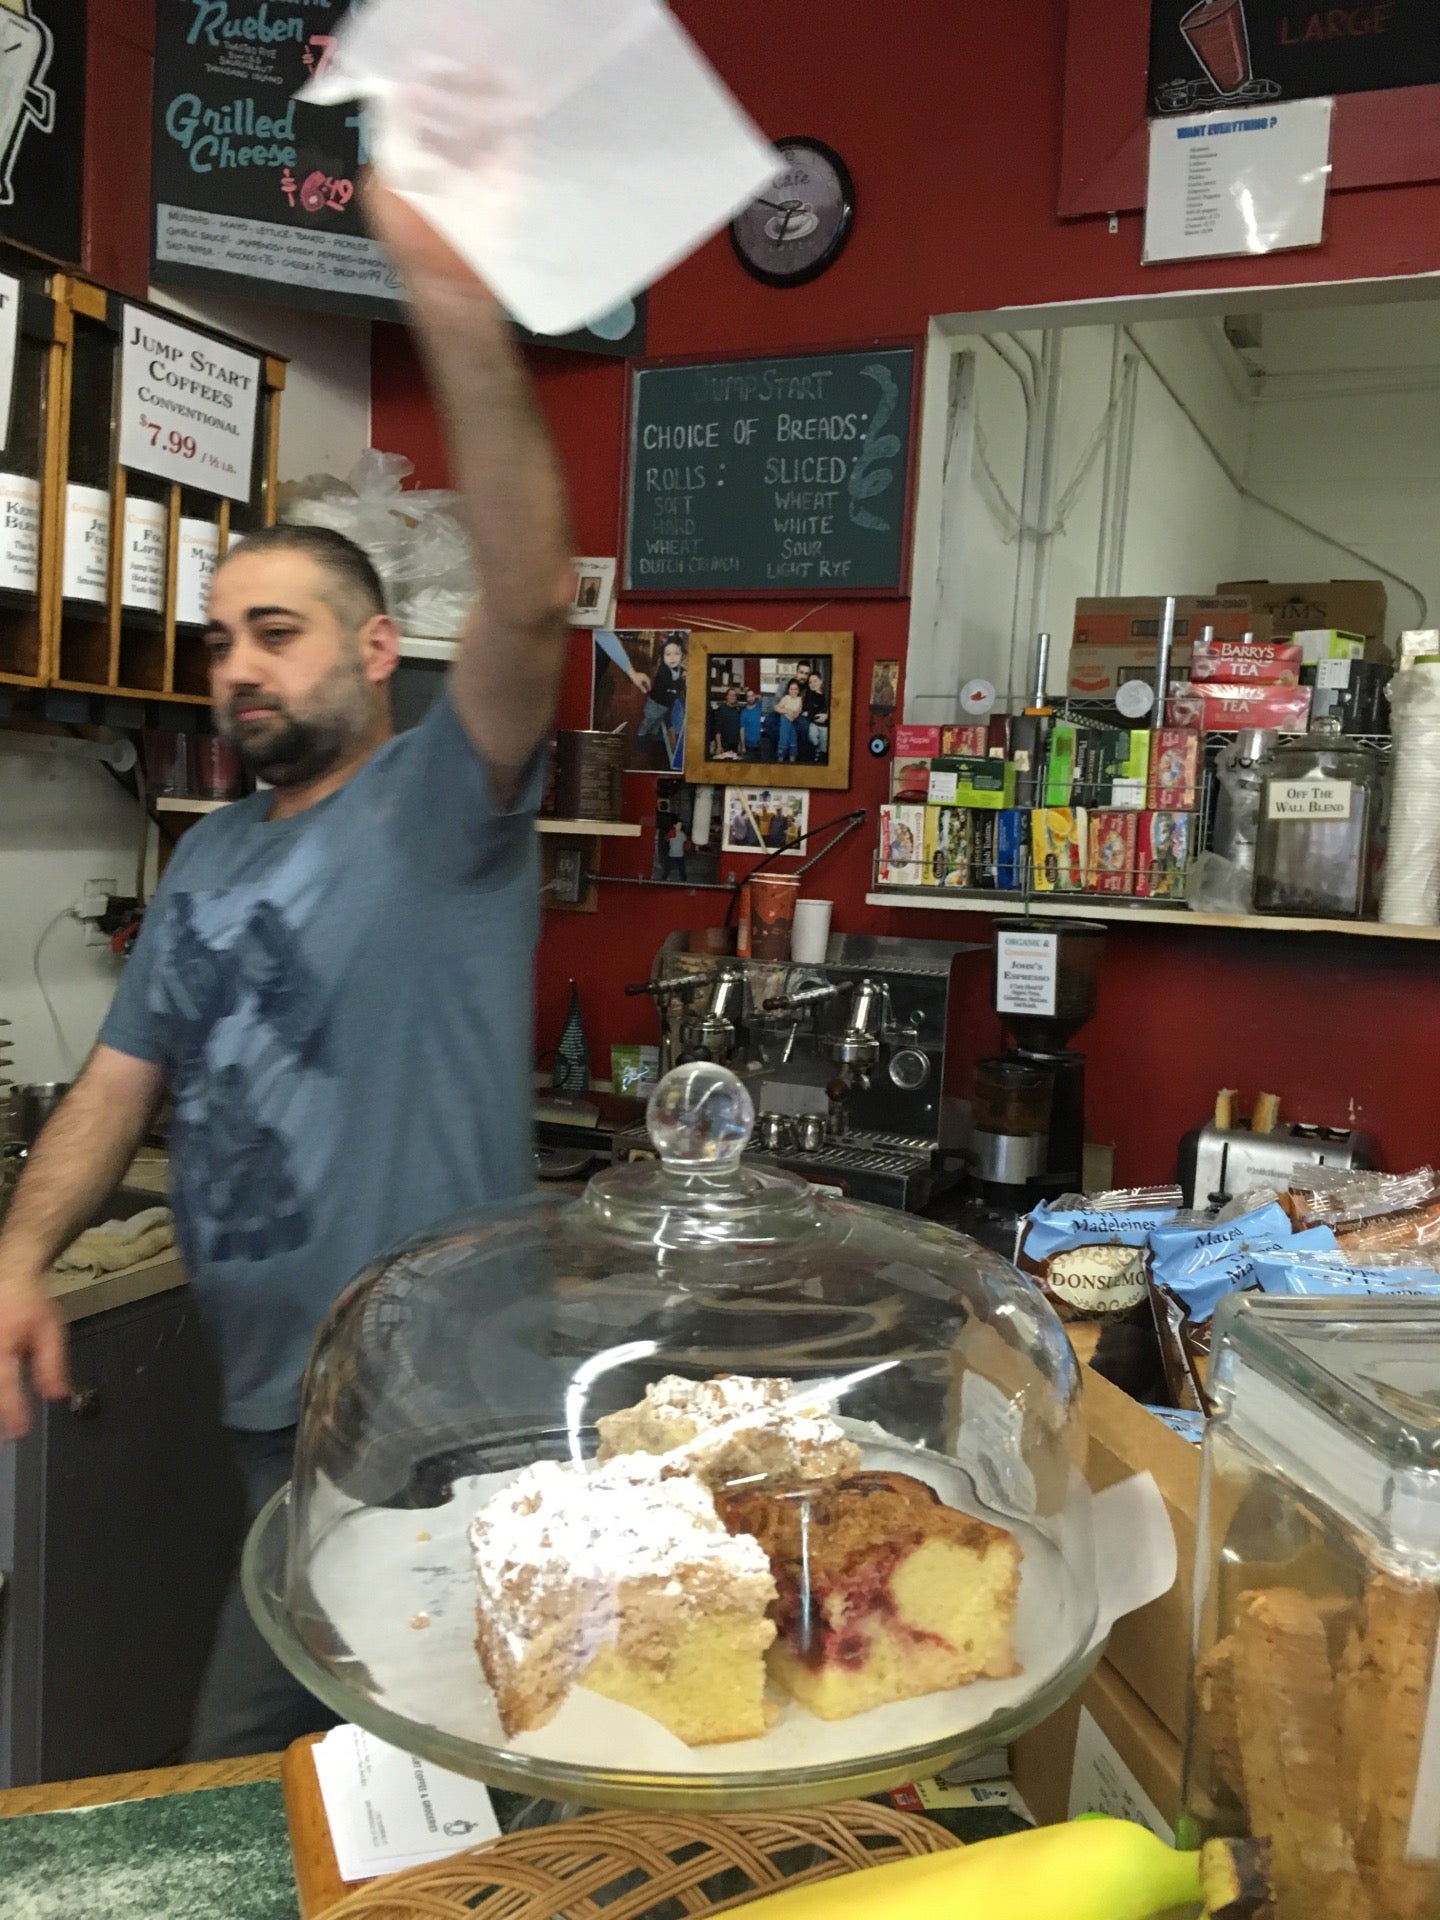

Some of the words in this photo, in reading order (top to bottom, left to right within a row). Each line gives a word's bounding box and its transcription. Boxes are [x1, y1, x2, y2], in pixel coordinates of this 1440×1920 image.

[186, 0, 305, 46] Rueben
[1280, 5, 1391, 46] LARGE
[166, 92, 296, 149] Grilled
[189, 134, 298, 174] Cheese
[129, 326, 184, 362] JUMP
[189, 350, 252, 391] START
[148, 360, 235, 410] COFFEES
[137, 386, 241, 437] CONVENTIONAL
[138, 413, 198, 460] $7.99
[642, 421, 720, 450] CHOICE
[733, 417, 760, 446] OF
[776, 412, 870, 442] BREADS:
[774, 490, 840, 512] WHEAT
[773, 515, 835, 535] WHITE
[780, 538, 824, 560] SOUR
[1221, 642, 1275, 660] BARRY'S
[1229, 662, 1259, 677] TEA
[1222, 699, 1249, 713] TEA
[1275, 801, 1306, 814] WALL
[1308, 801, 1345, 814] BLEND
[1286, 787, 1309, 800] OFF
[1310, 787, 1335, 799] THE
[1071, 1217, 1158, 1234] Madeleines
